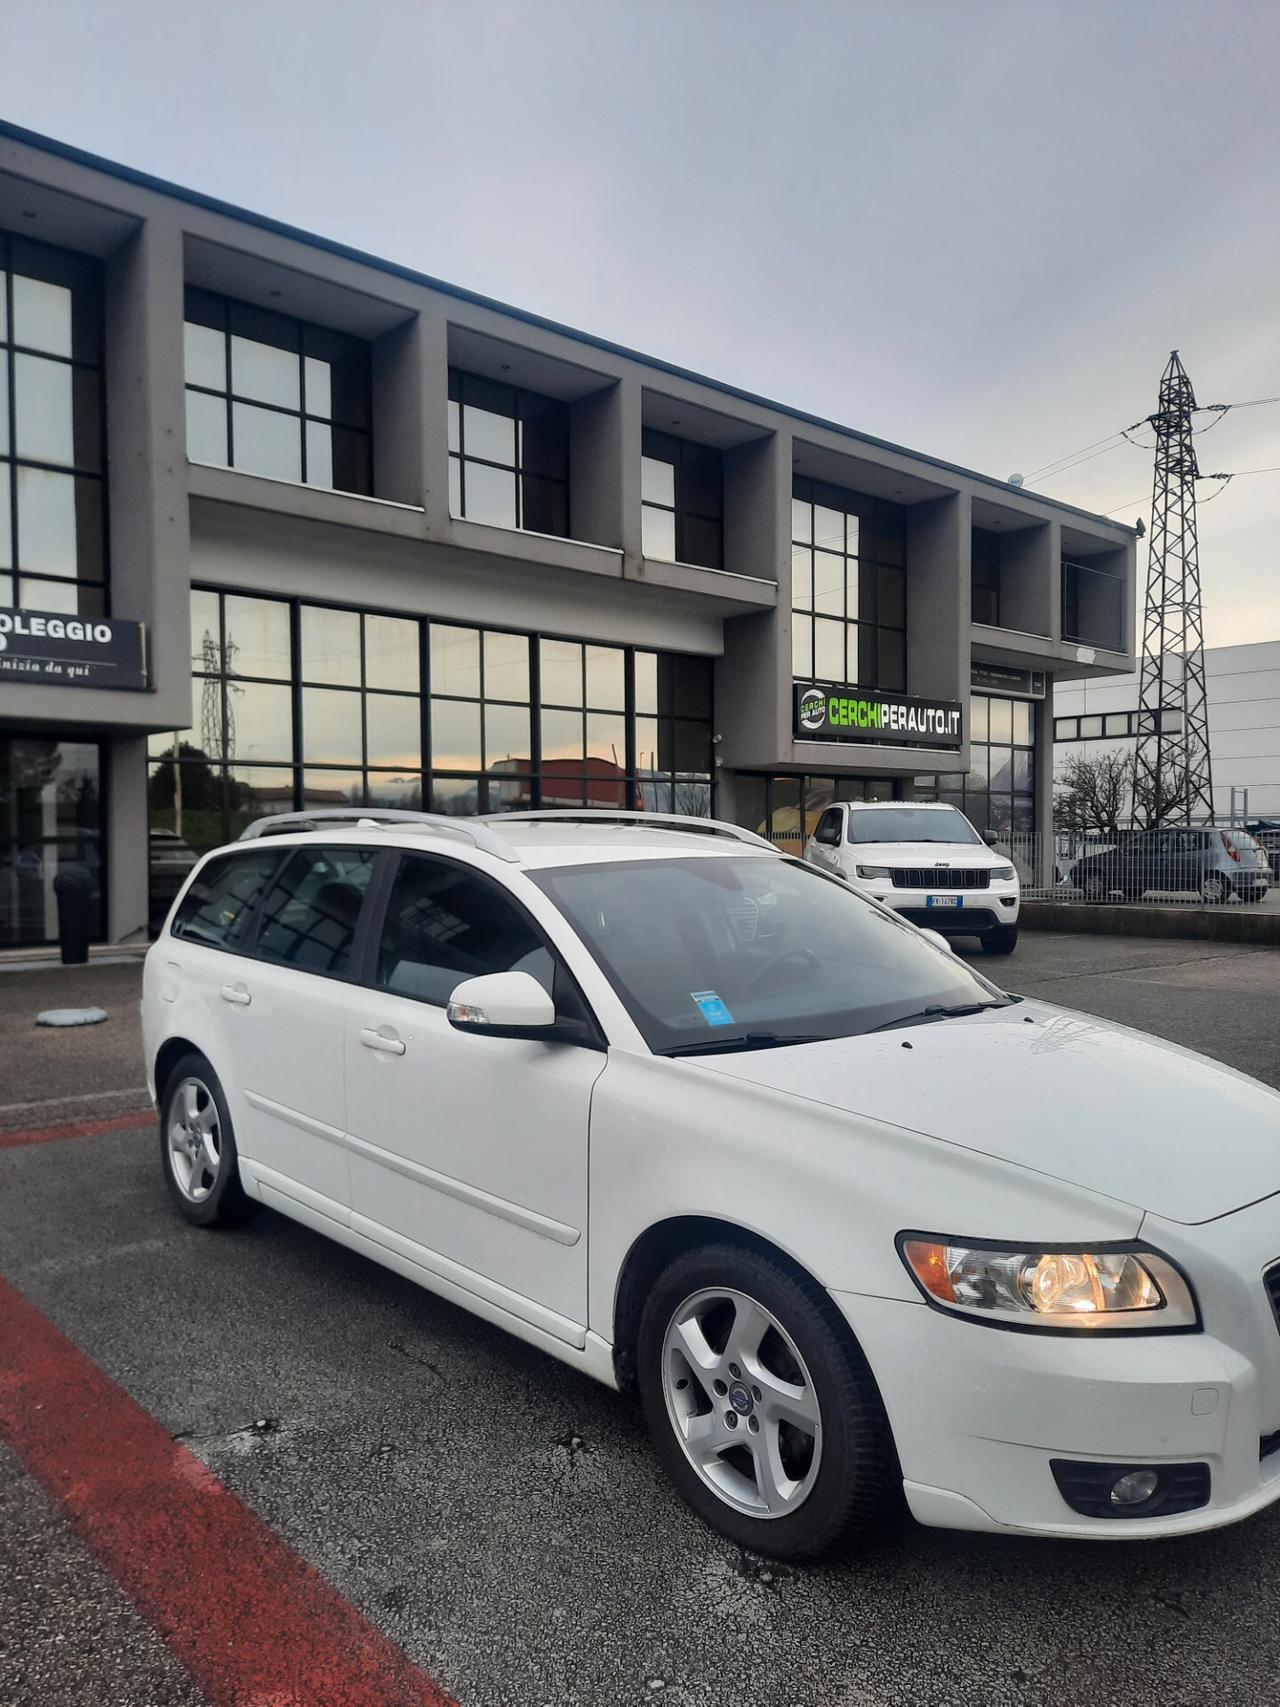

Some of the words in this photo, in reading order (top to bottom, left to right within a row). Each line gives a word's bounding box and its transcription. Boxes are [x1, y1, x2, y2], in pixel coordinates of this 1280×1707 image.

[0, 613, 112, 643] OLEGGIO
[45, 661, 62, 674] da
[67, 665, 90, 678] qui
[829, 697, 960, 735] CERCHIPERAUTO.IT
